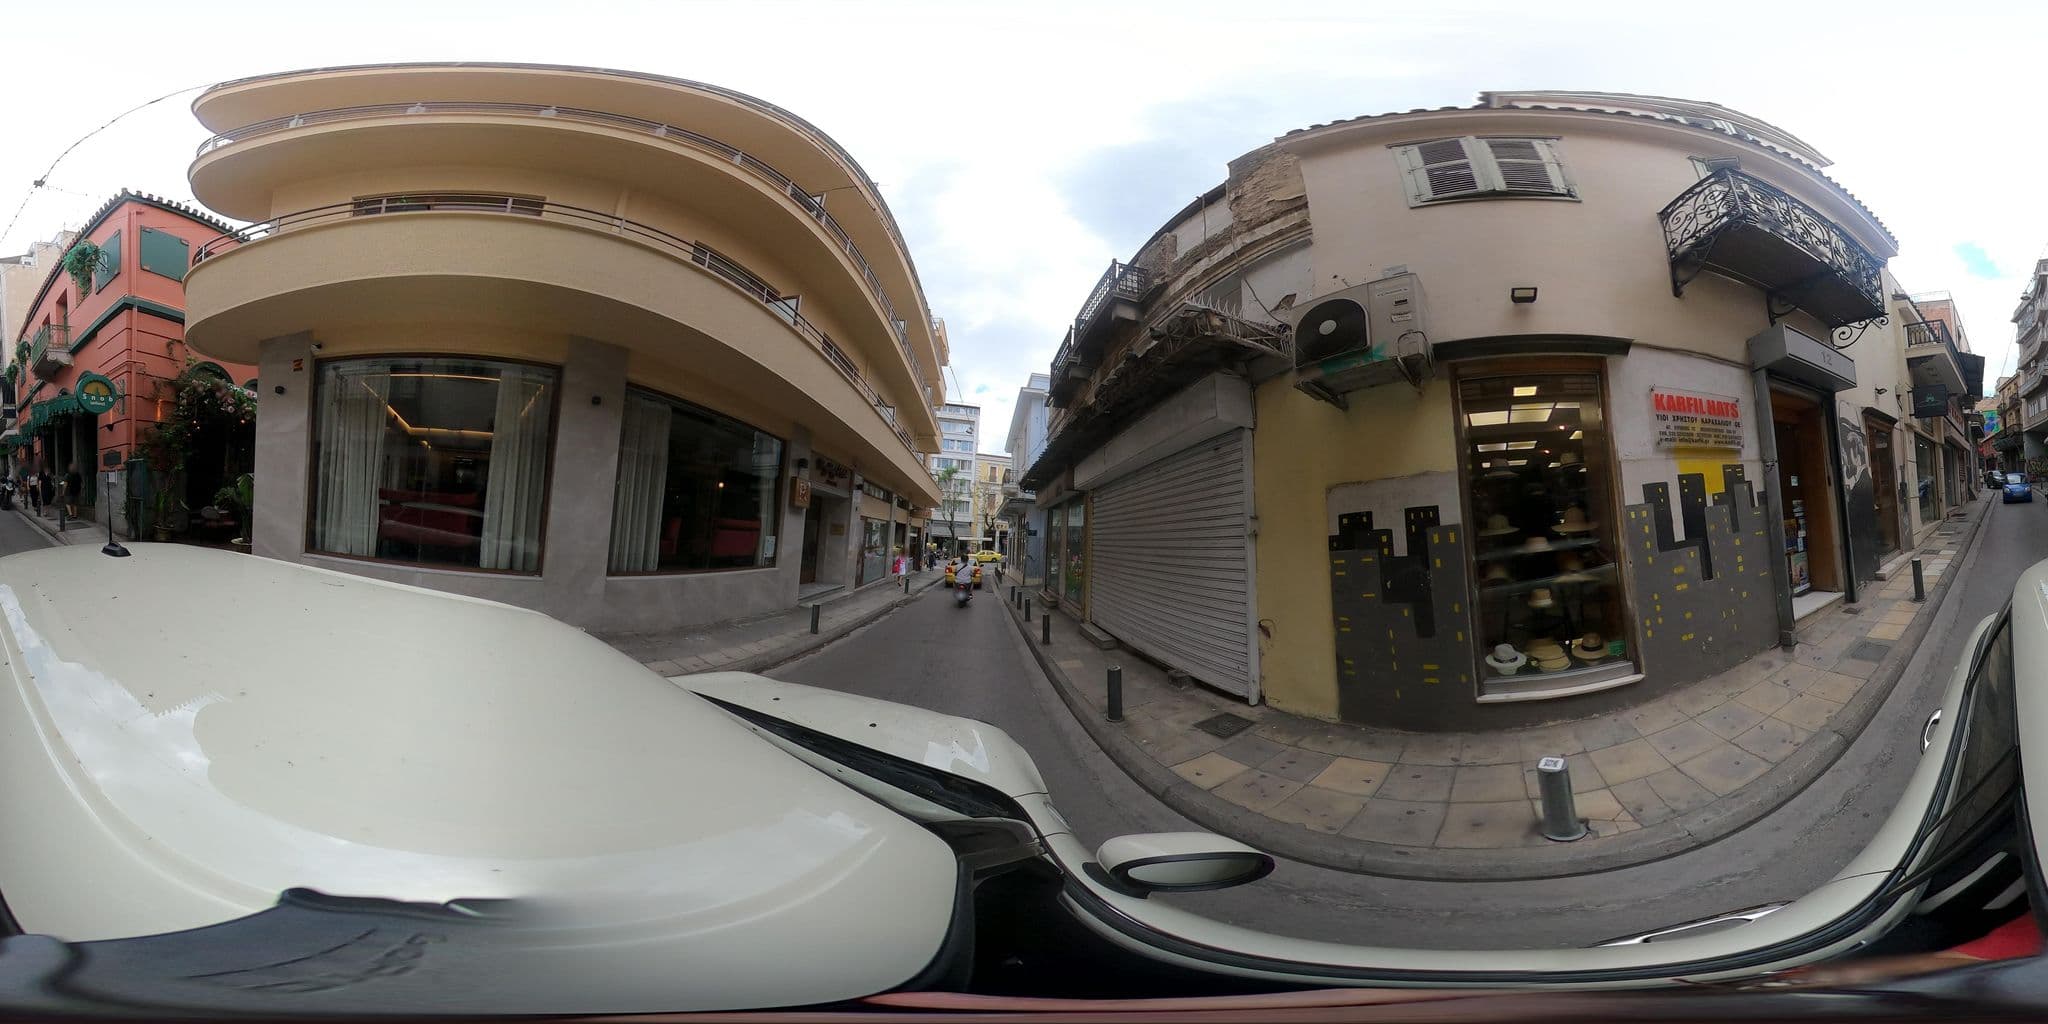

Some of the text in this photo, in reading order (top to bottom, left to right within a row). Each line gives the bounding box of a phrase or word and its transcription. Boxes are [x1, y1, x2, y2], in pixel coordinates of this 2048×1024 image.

[82, 393, 113, 402] Snob
[1654, 393, 1739, 418] KARFIL HATS
